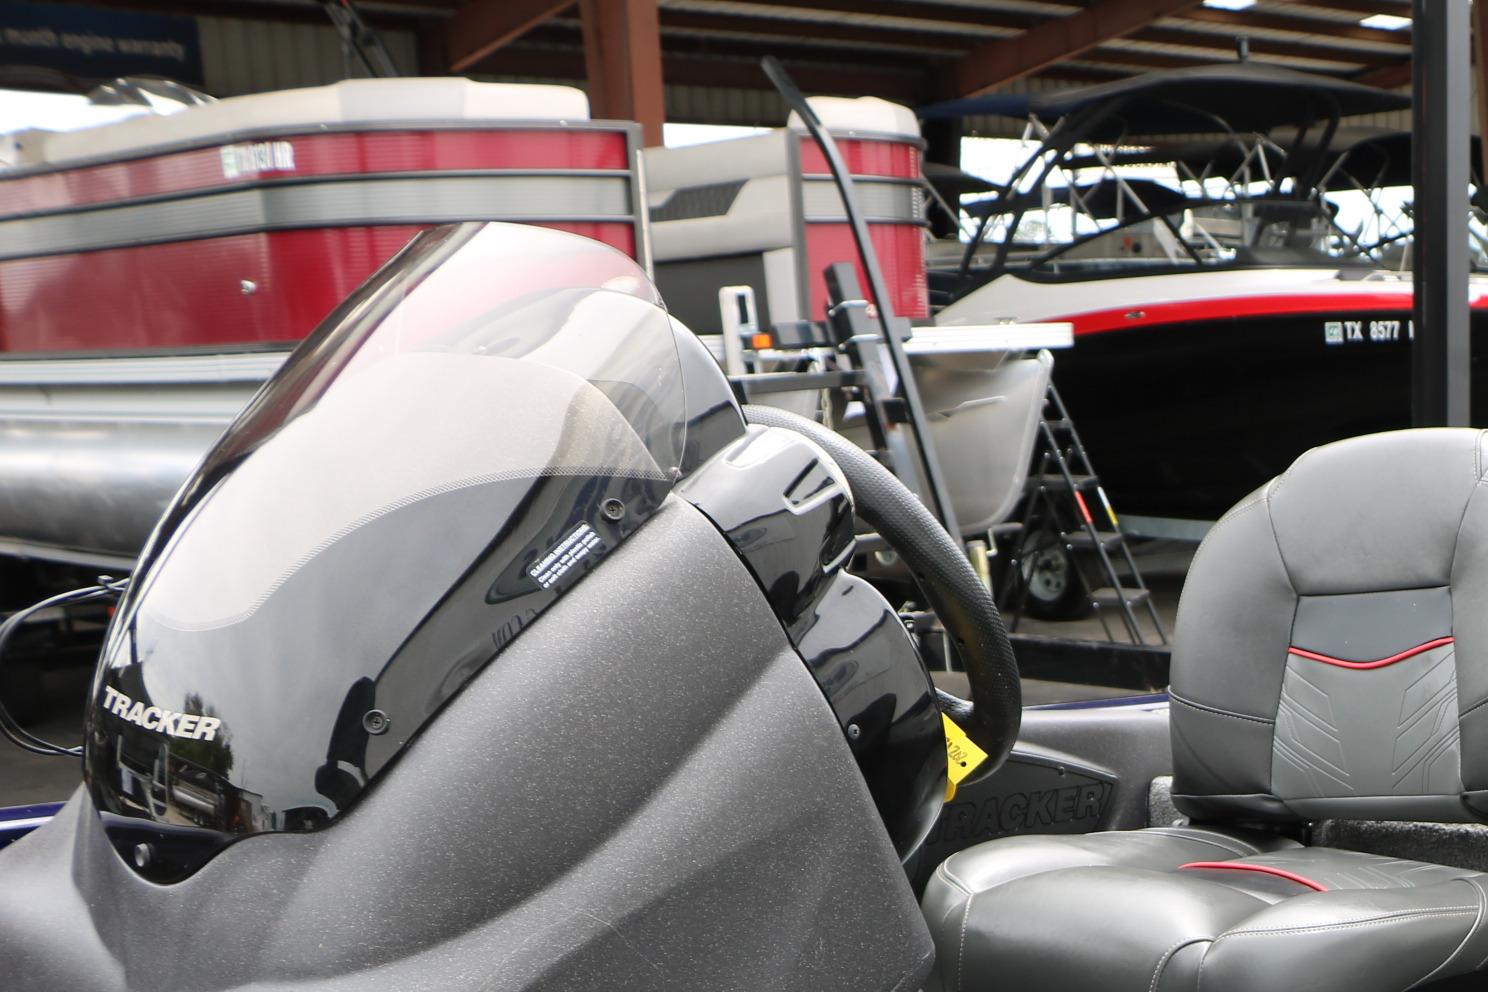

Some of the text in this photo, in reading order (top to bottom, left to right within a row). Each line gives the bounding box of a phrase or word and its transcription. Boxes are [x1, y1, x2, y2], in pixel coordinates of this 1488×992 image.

[117, 38, 186, 63] warranty
[1344, 321, 1363, 339] TX
[1369, 320, 1400, 339] 8577
[103, 685, 221, 741] TRACKER
